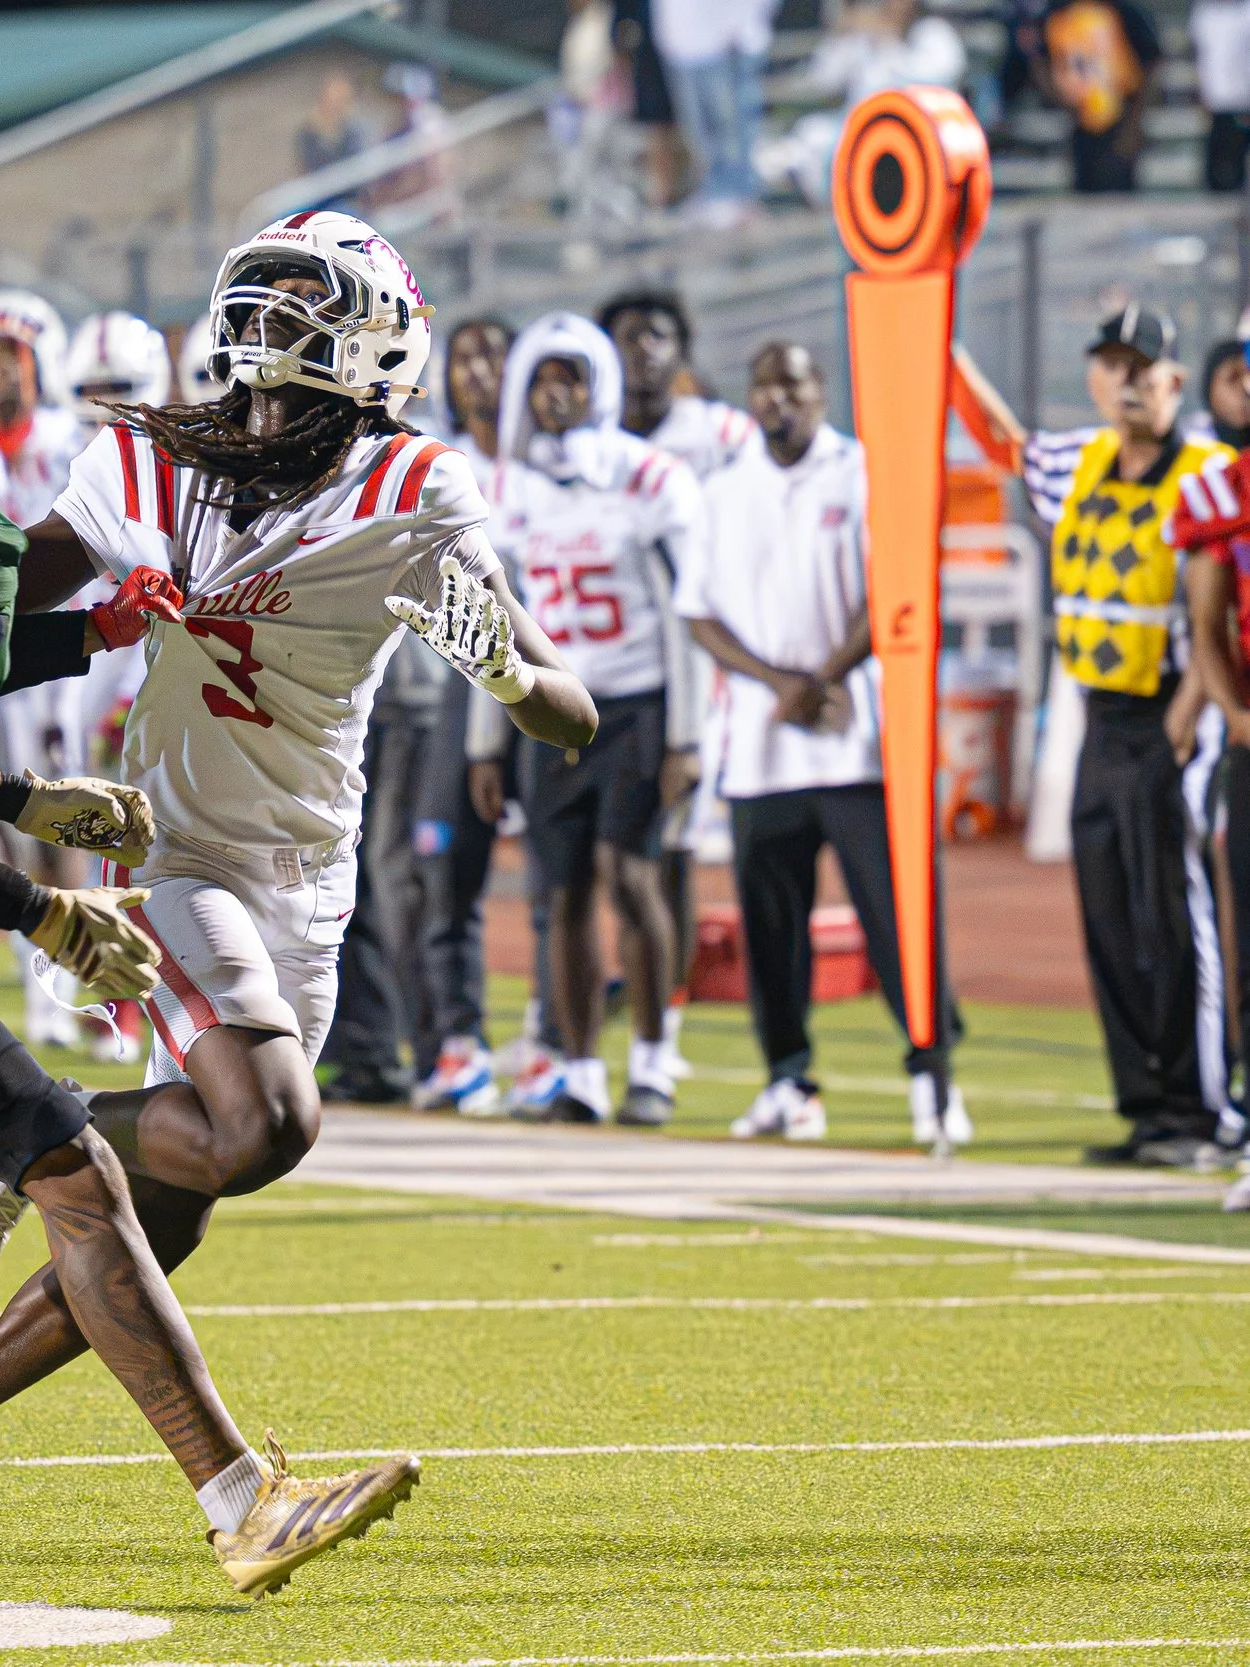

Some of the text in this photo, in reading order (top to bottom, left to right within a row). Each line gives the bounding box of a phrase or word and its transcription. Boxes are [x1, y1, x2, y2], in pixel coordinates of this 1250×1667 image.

[257, 231, 307, 241] Riddell
[528, 564, 624, 642] 25
[184, 616, 274, 729] 3
